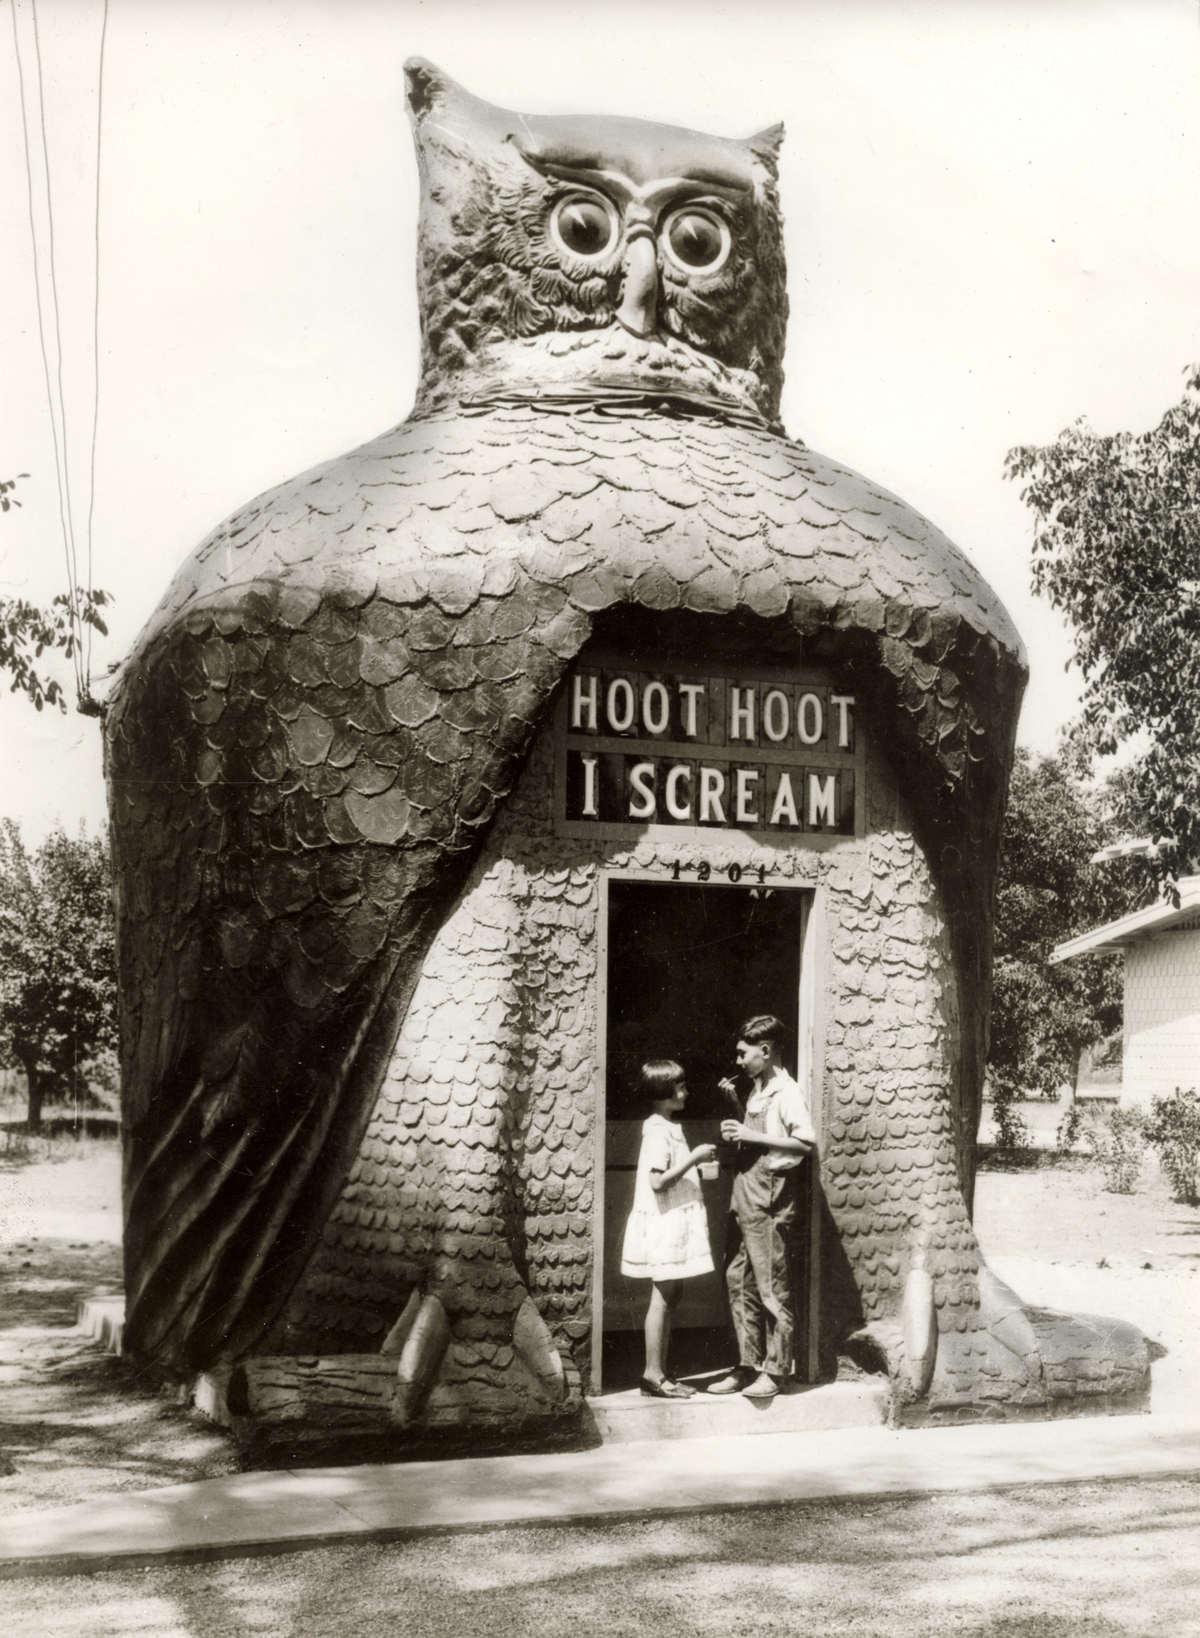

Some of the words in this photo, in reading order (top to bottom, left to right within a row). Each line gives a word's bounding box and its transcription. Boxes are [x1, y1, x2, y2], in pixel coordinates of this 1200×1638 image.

[572, 675, 704, 736] HOOT
[731, 687, 855, 747] HOOT
[582, 759, 598, 816] I
[629, 762, 836, 827] SCREAM
